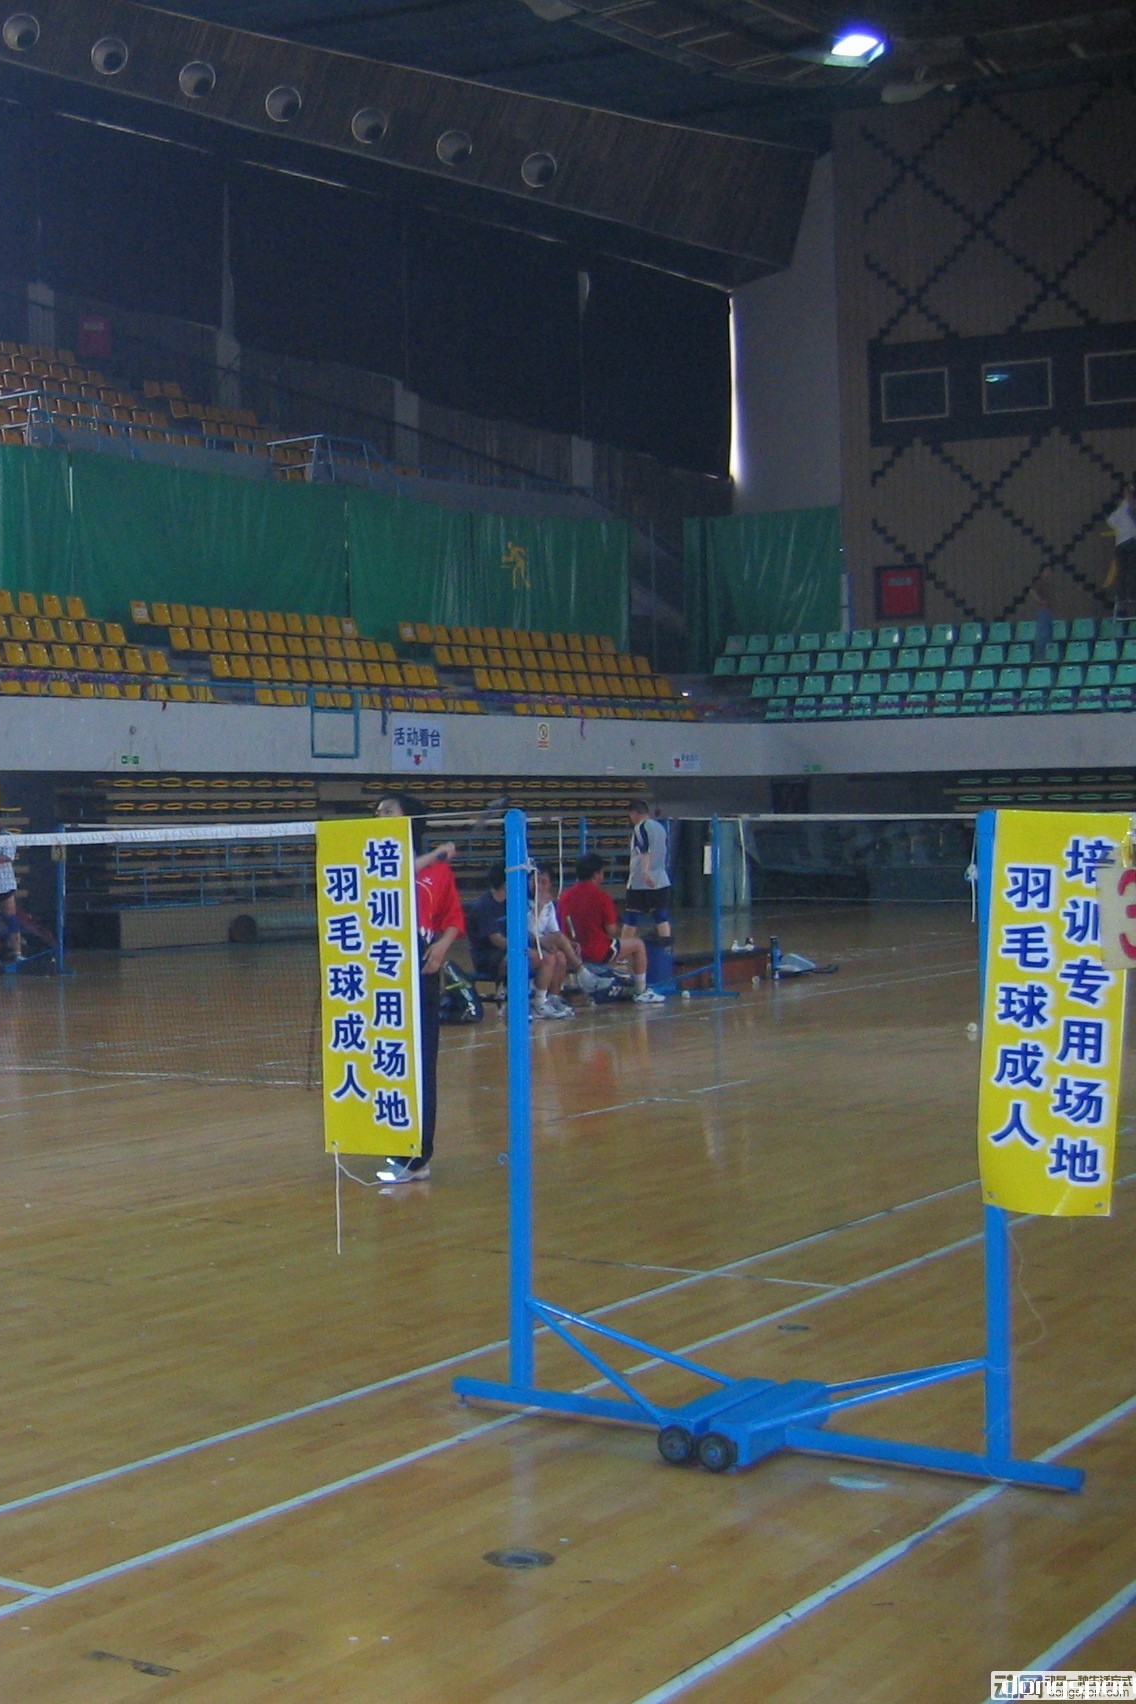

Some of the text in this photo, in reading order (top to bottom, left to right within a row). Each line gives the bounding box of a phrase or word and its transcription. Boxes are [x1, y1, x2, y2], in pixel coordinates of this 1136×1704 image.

[393, 727, 441, 747] 活动看台
[324, 865, 367, 1100] 羽毛球成人
[364, 839, 410, 1128] 培训专用场地
[990, 865, 1052, 1148] 羽毛球成人
[1049, 838, 1115, 1184] 培训专用场地
